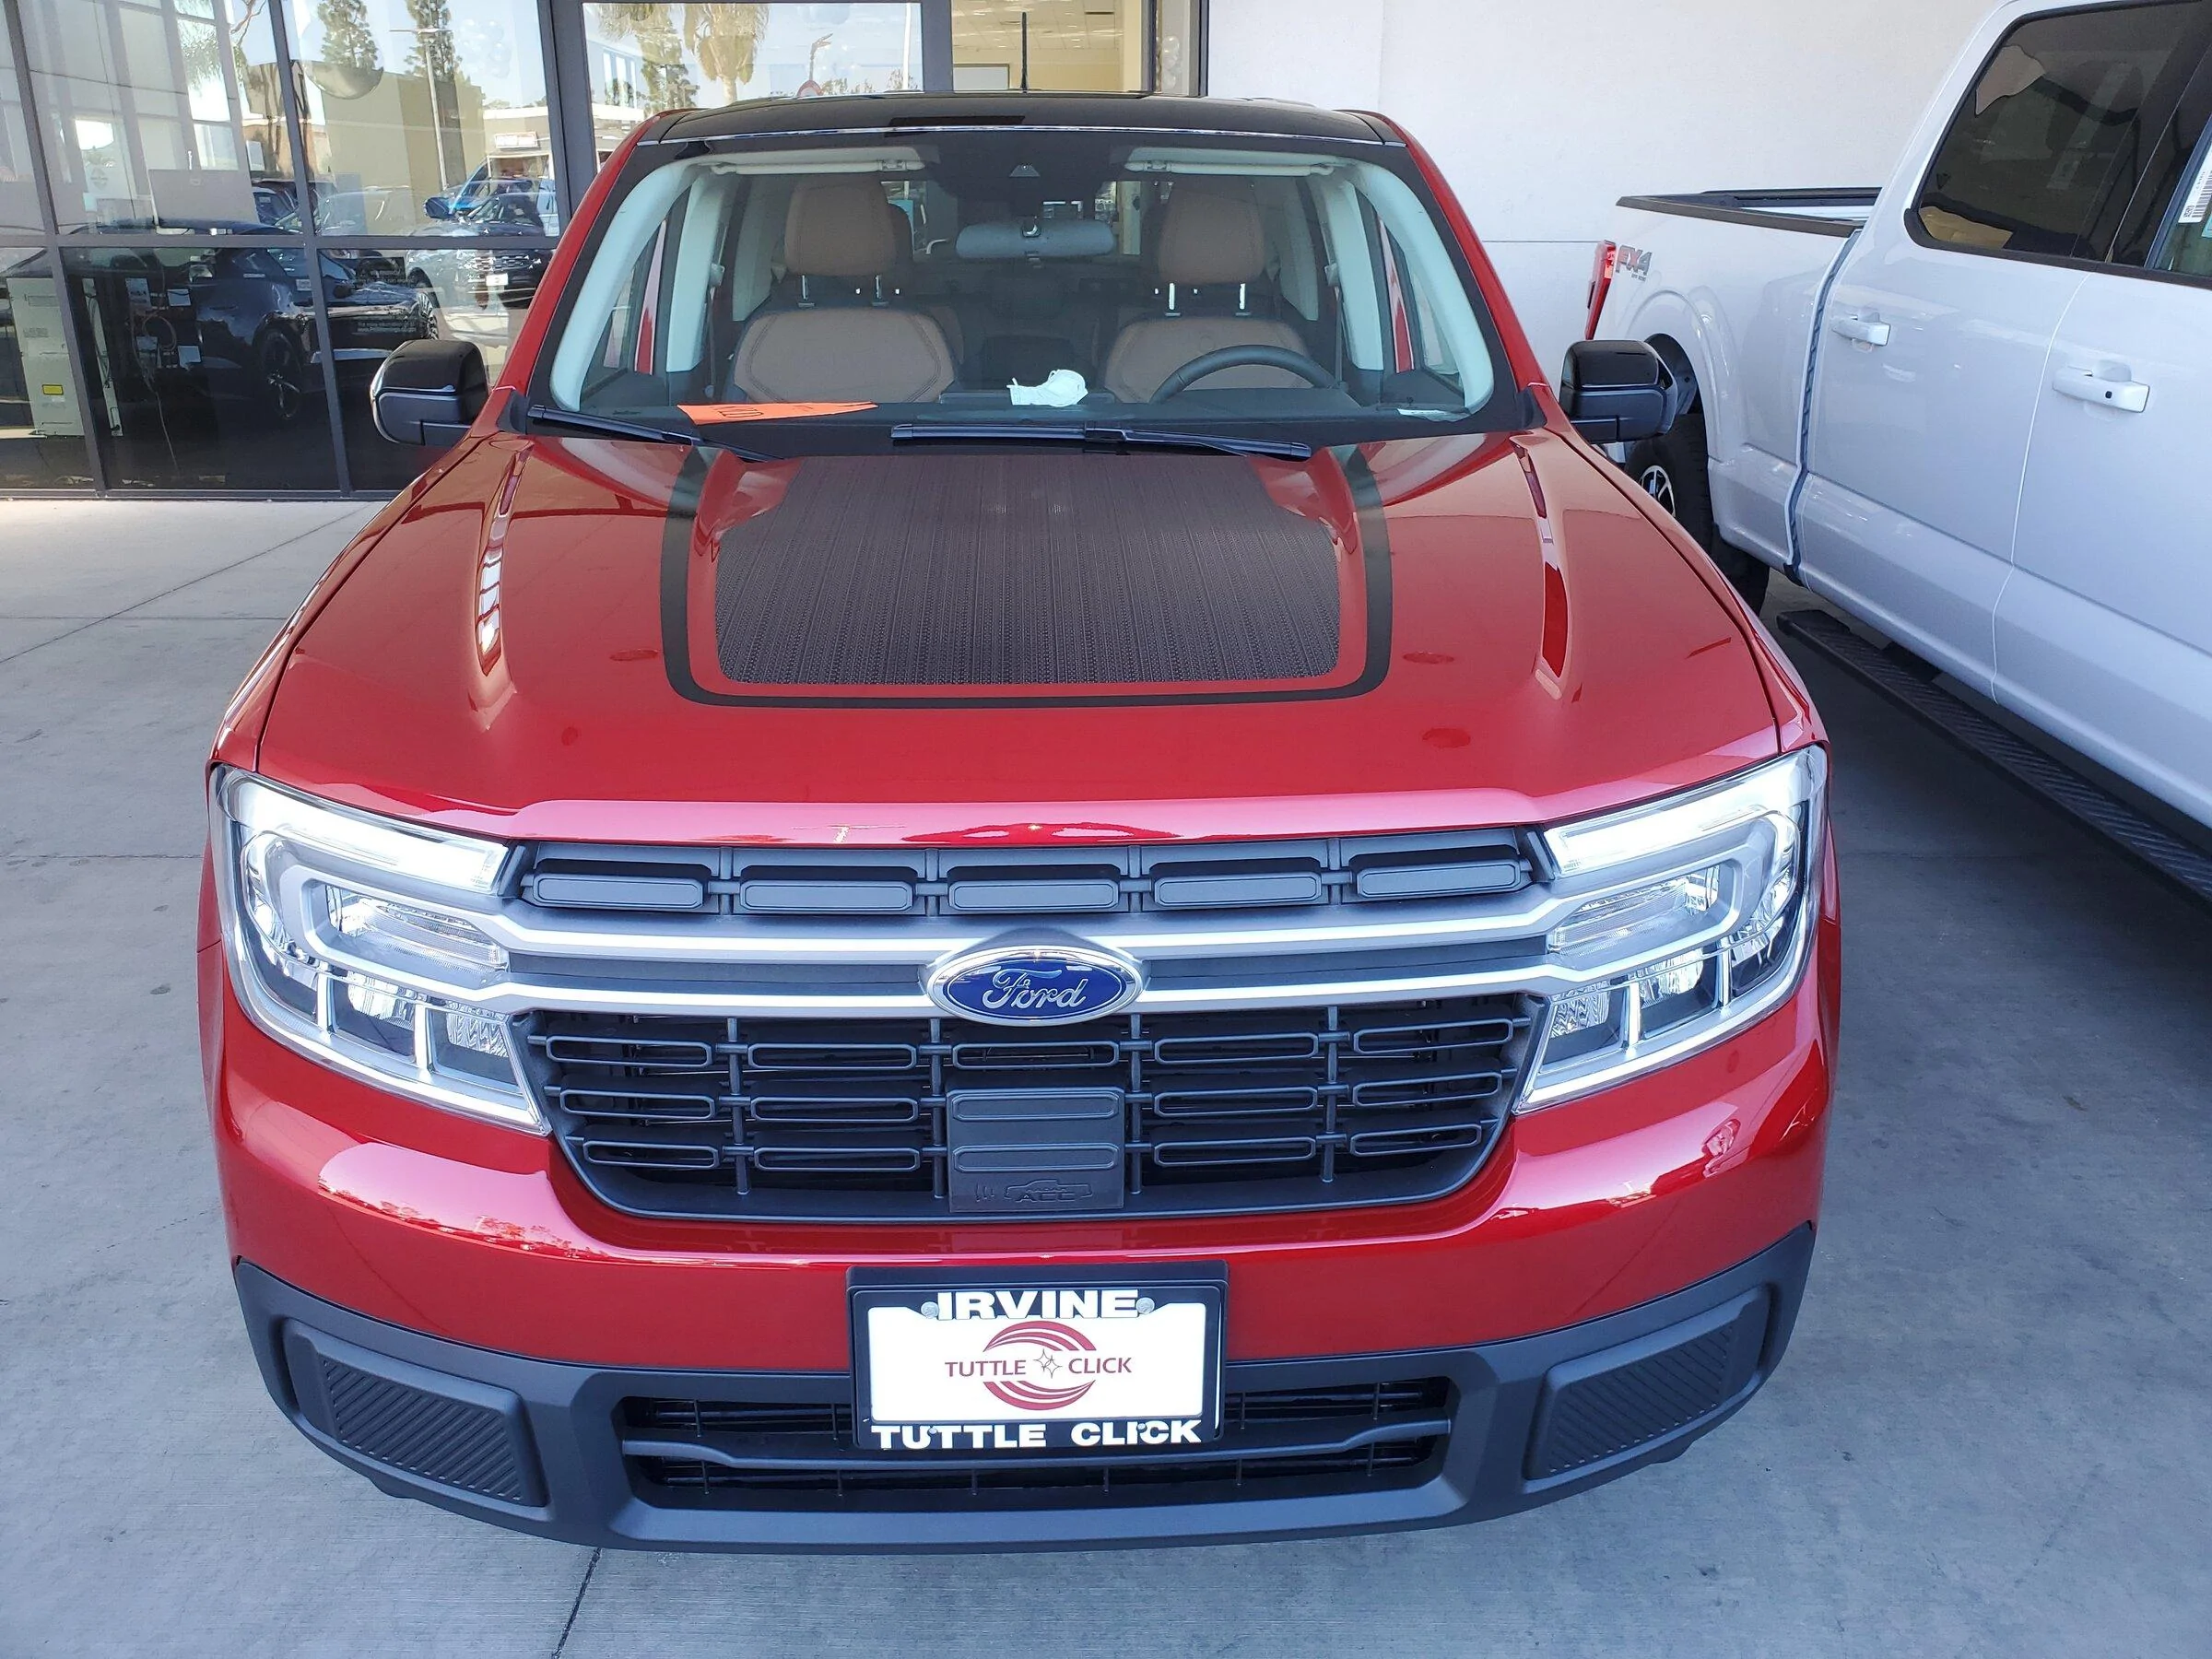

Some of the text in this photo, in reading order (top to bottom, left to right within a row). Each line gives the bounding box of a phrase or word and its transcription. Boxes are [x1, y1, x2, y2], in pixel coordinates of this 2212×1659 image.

[1616, 245, 1652, 276] FX4
[982, 968, 1088, 1009] Ford
[937, 1289, 1139, 1320] IRVINE
[945, 1358, 1133, 1378] TUTTLE CLICK
[871, 1420, 1202, 1449] TUTTLE CLICK
